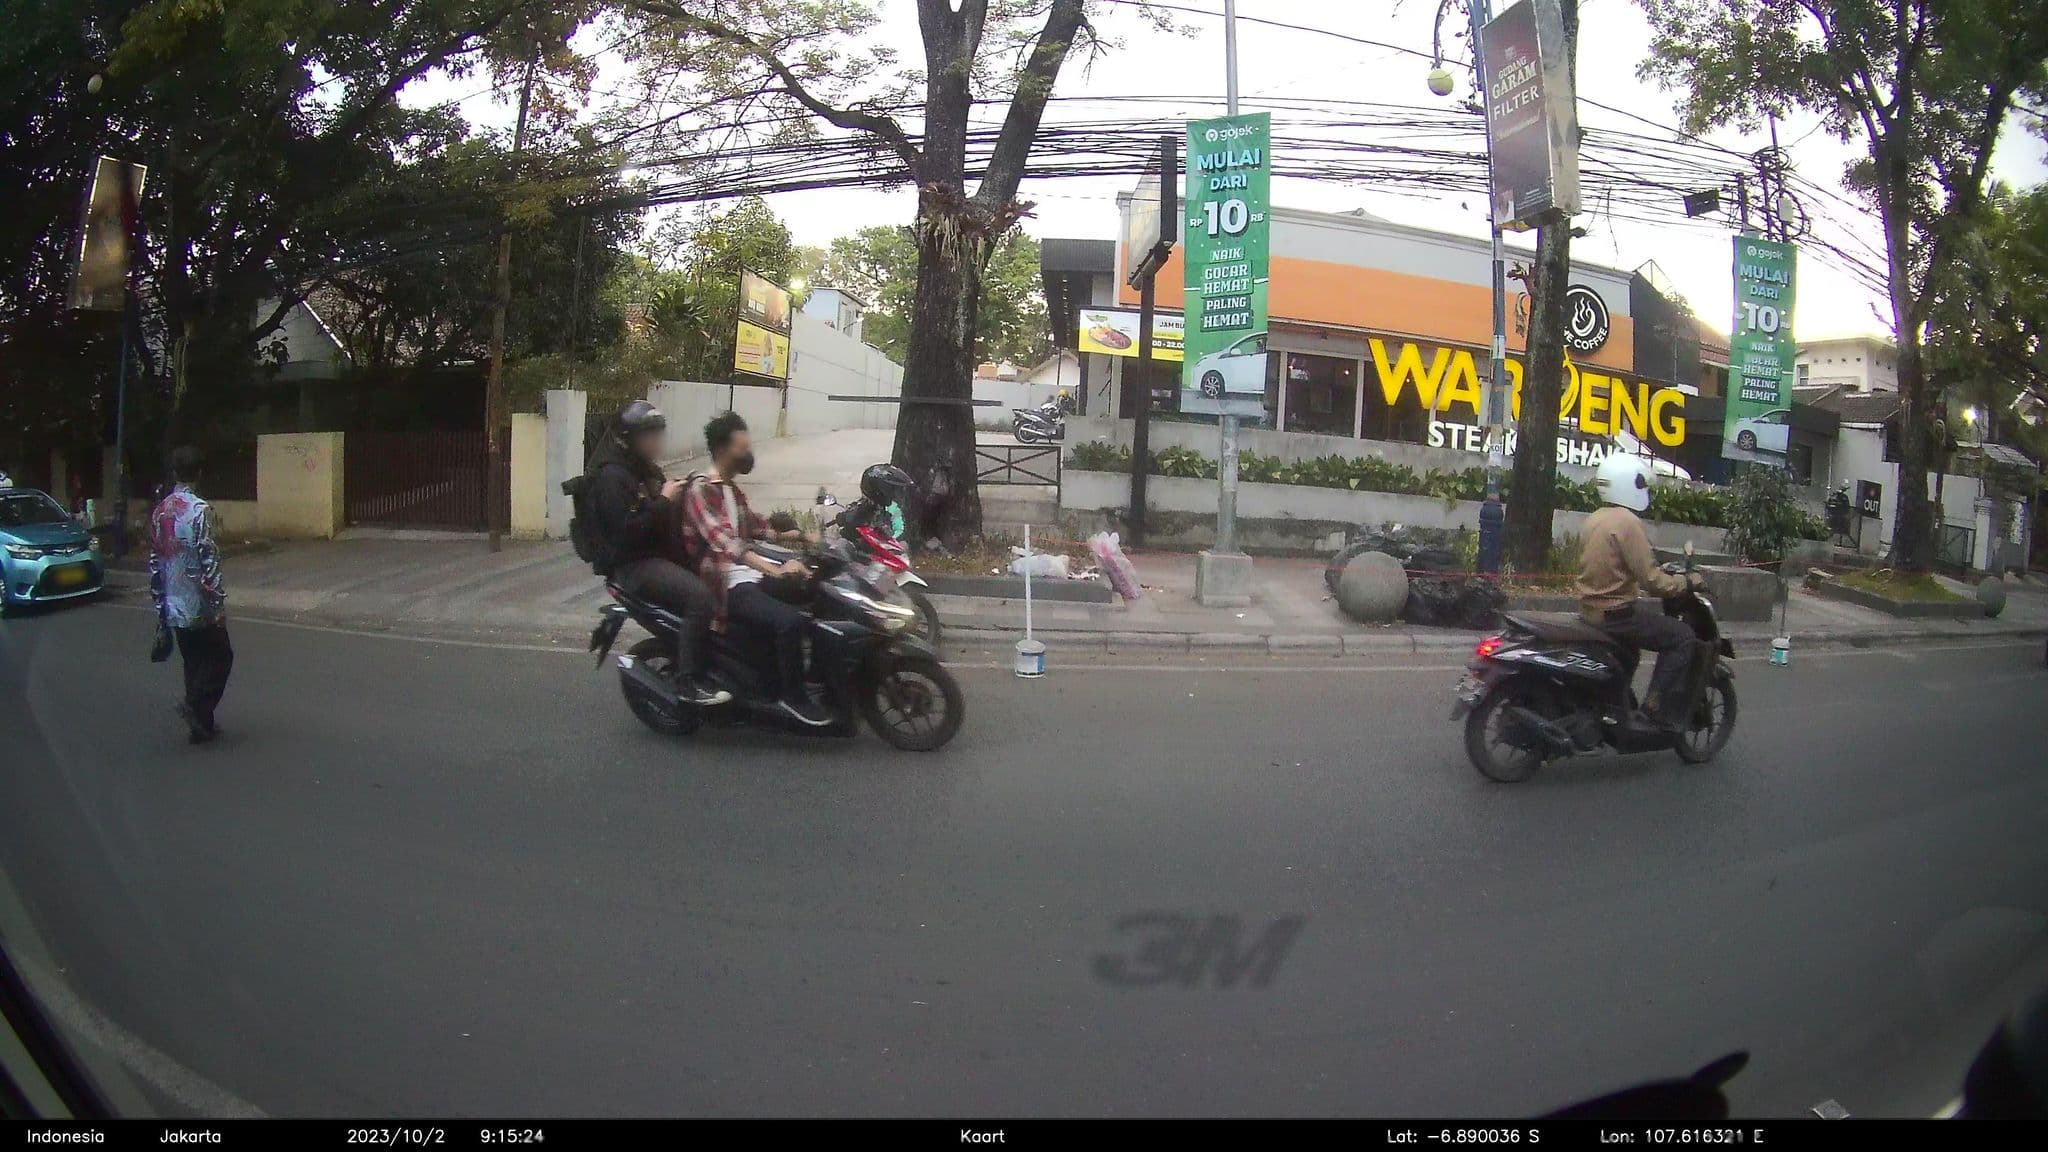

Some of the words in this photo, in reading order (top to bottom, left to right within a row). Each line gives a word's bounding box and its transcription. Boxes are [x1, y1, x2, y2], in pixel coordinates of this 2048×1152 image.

[1498, 55, 1527, 79] GUDANG
[1491, 60, 1537, 99] GARAM
[1493, 85, 1539, 120] FILTER
[1220, 125, 1253, 141] gojek
[1197, 148, 1261, 171] MULAI
[1210, 174, 1247, 190] DARI
[1189, 218, 1203, 227] RP
[1203, 199, 1248, 235] 10
[1250, 213, 1264, 222] RB
[1212, 248, 1242, 261] NAIK
[1204, 264, 1248, 279] GOCAR
[1740, 264, 1789, 284] MULAI
[1203, 278, 1250, 294] HEMAT
[1750, 284, 1778, 299] DARI
[1206, 297, 1247, 311] PALING
[1203, 312, 1250, 328] HEMAT
[1743, 302, 1779, 332] 10
[1574, 327, 1608, 350] COFFEE
[1743, 364, 1779, 377] HEMAT
[1744, 377, 1776, 389] PALING
[1741, 389, 1778, 402] HEMAT
[1556, 436, 1616, 467] SHA
[1863, 499, 1880, 512] OUT
[1094, 909, 1306, 989] 3M
